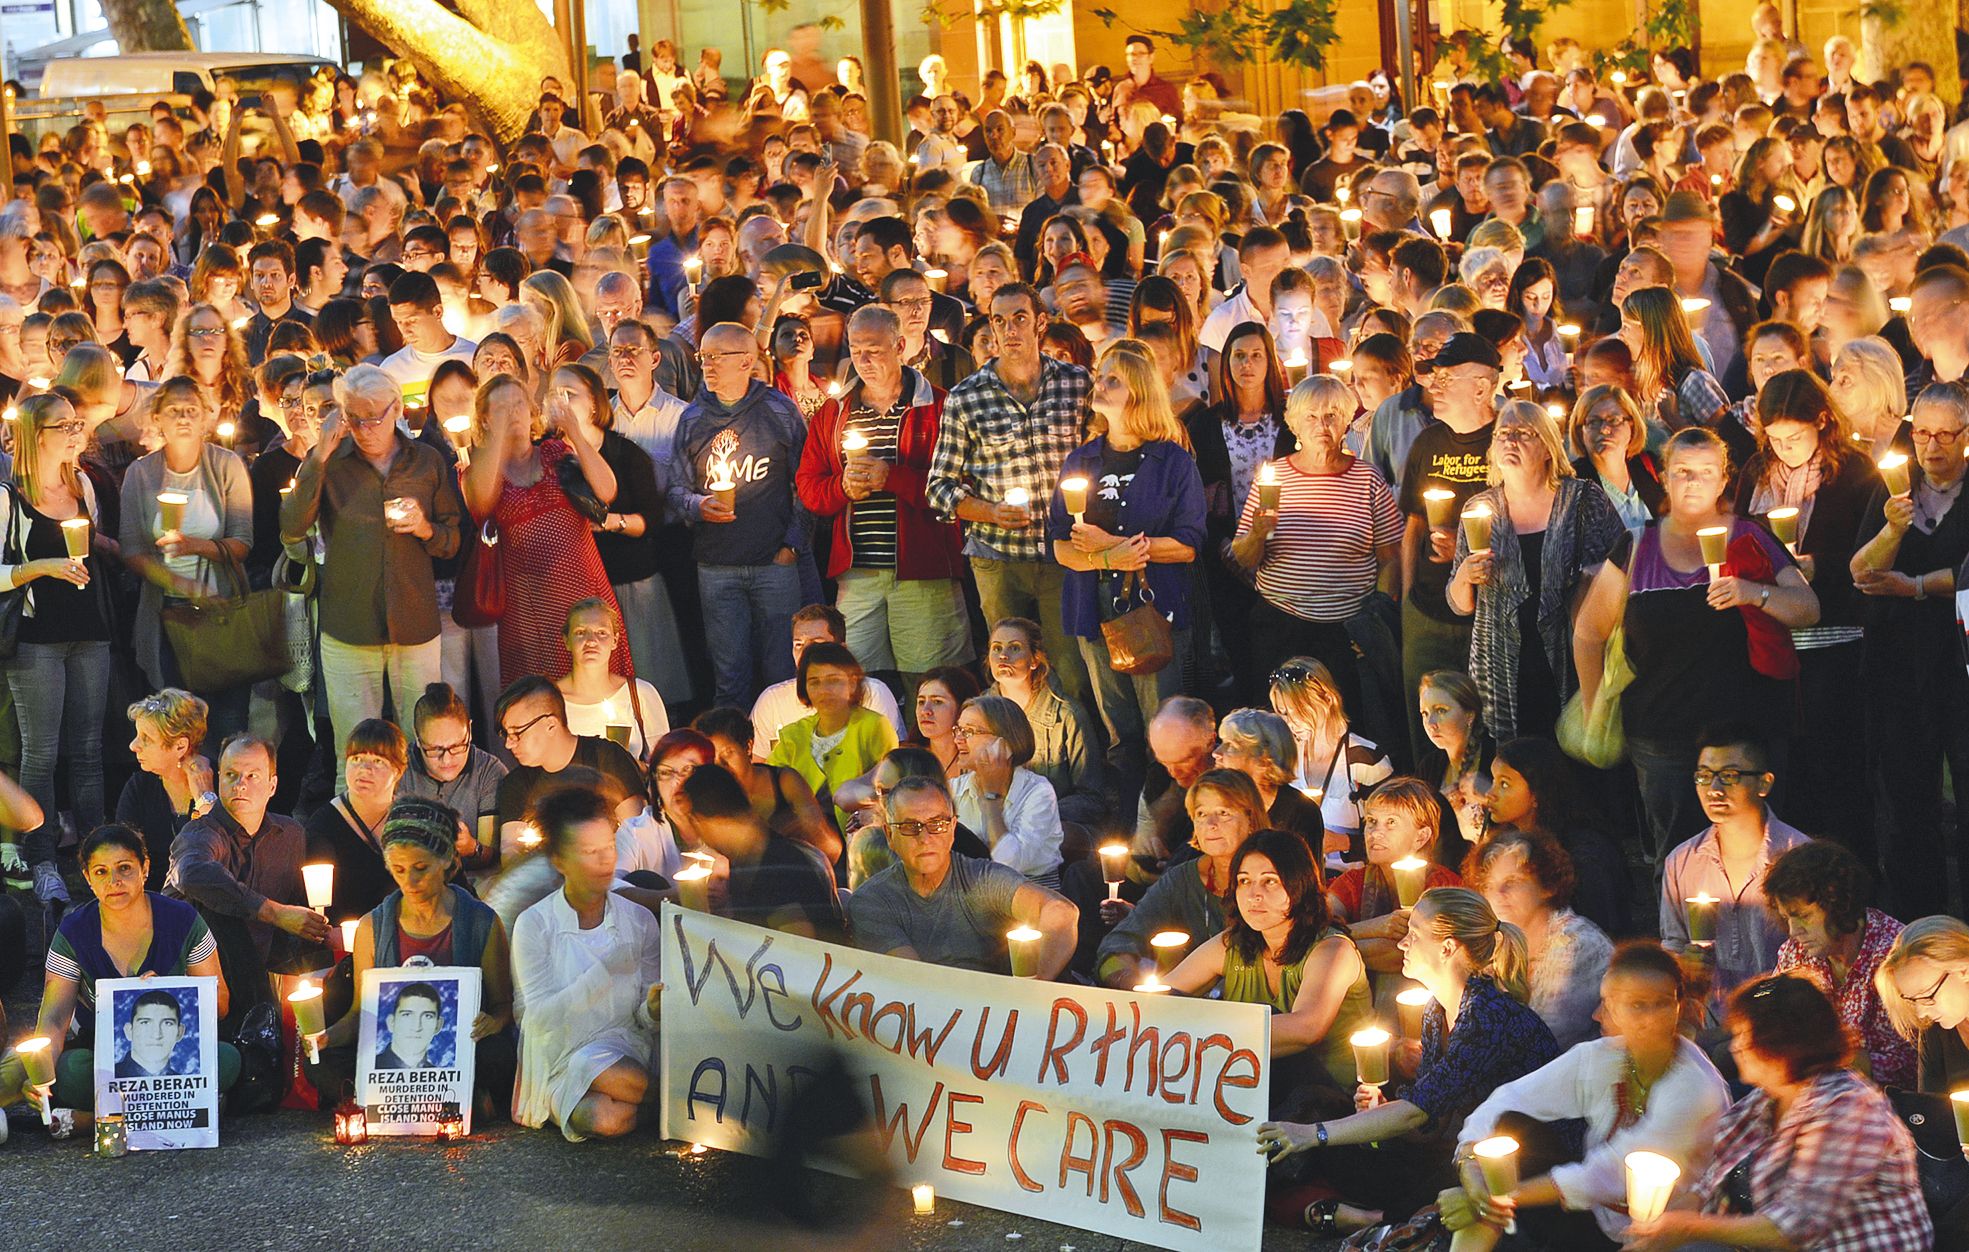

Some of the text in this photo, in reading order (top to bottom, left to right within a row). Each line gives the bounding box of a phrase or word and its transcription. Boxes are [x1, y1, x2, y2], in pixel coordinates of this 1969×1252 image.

[1432, 453, 1482, 466] Labor for
[673, 914, 803, 1032] We
[368, 1071, 461, 1084] REZA BERATI
[108, 1077, 207, 1094] REZA BERATI
[379, 1083, 449, 1094] MURDERED IN
[184, 1090, 195, 1099] IN
[384, 1094, 442, 1103] DETENTION
[127, 1100, 189, 1112] DETENTION
[377, 1103, 443, 1114] CLOSE MANU
[156, 1109, 197, 1120] MANUS
[380, 1113, 438, 1123] ISLAND NO
[166, 1119, 194, 1130] NOW
[869, 1073, 987, 1176] WE
[1007, 1099, 1210, 1234] CARE
